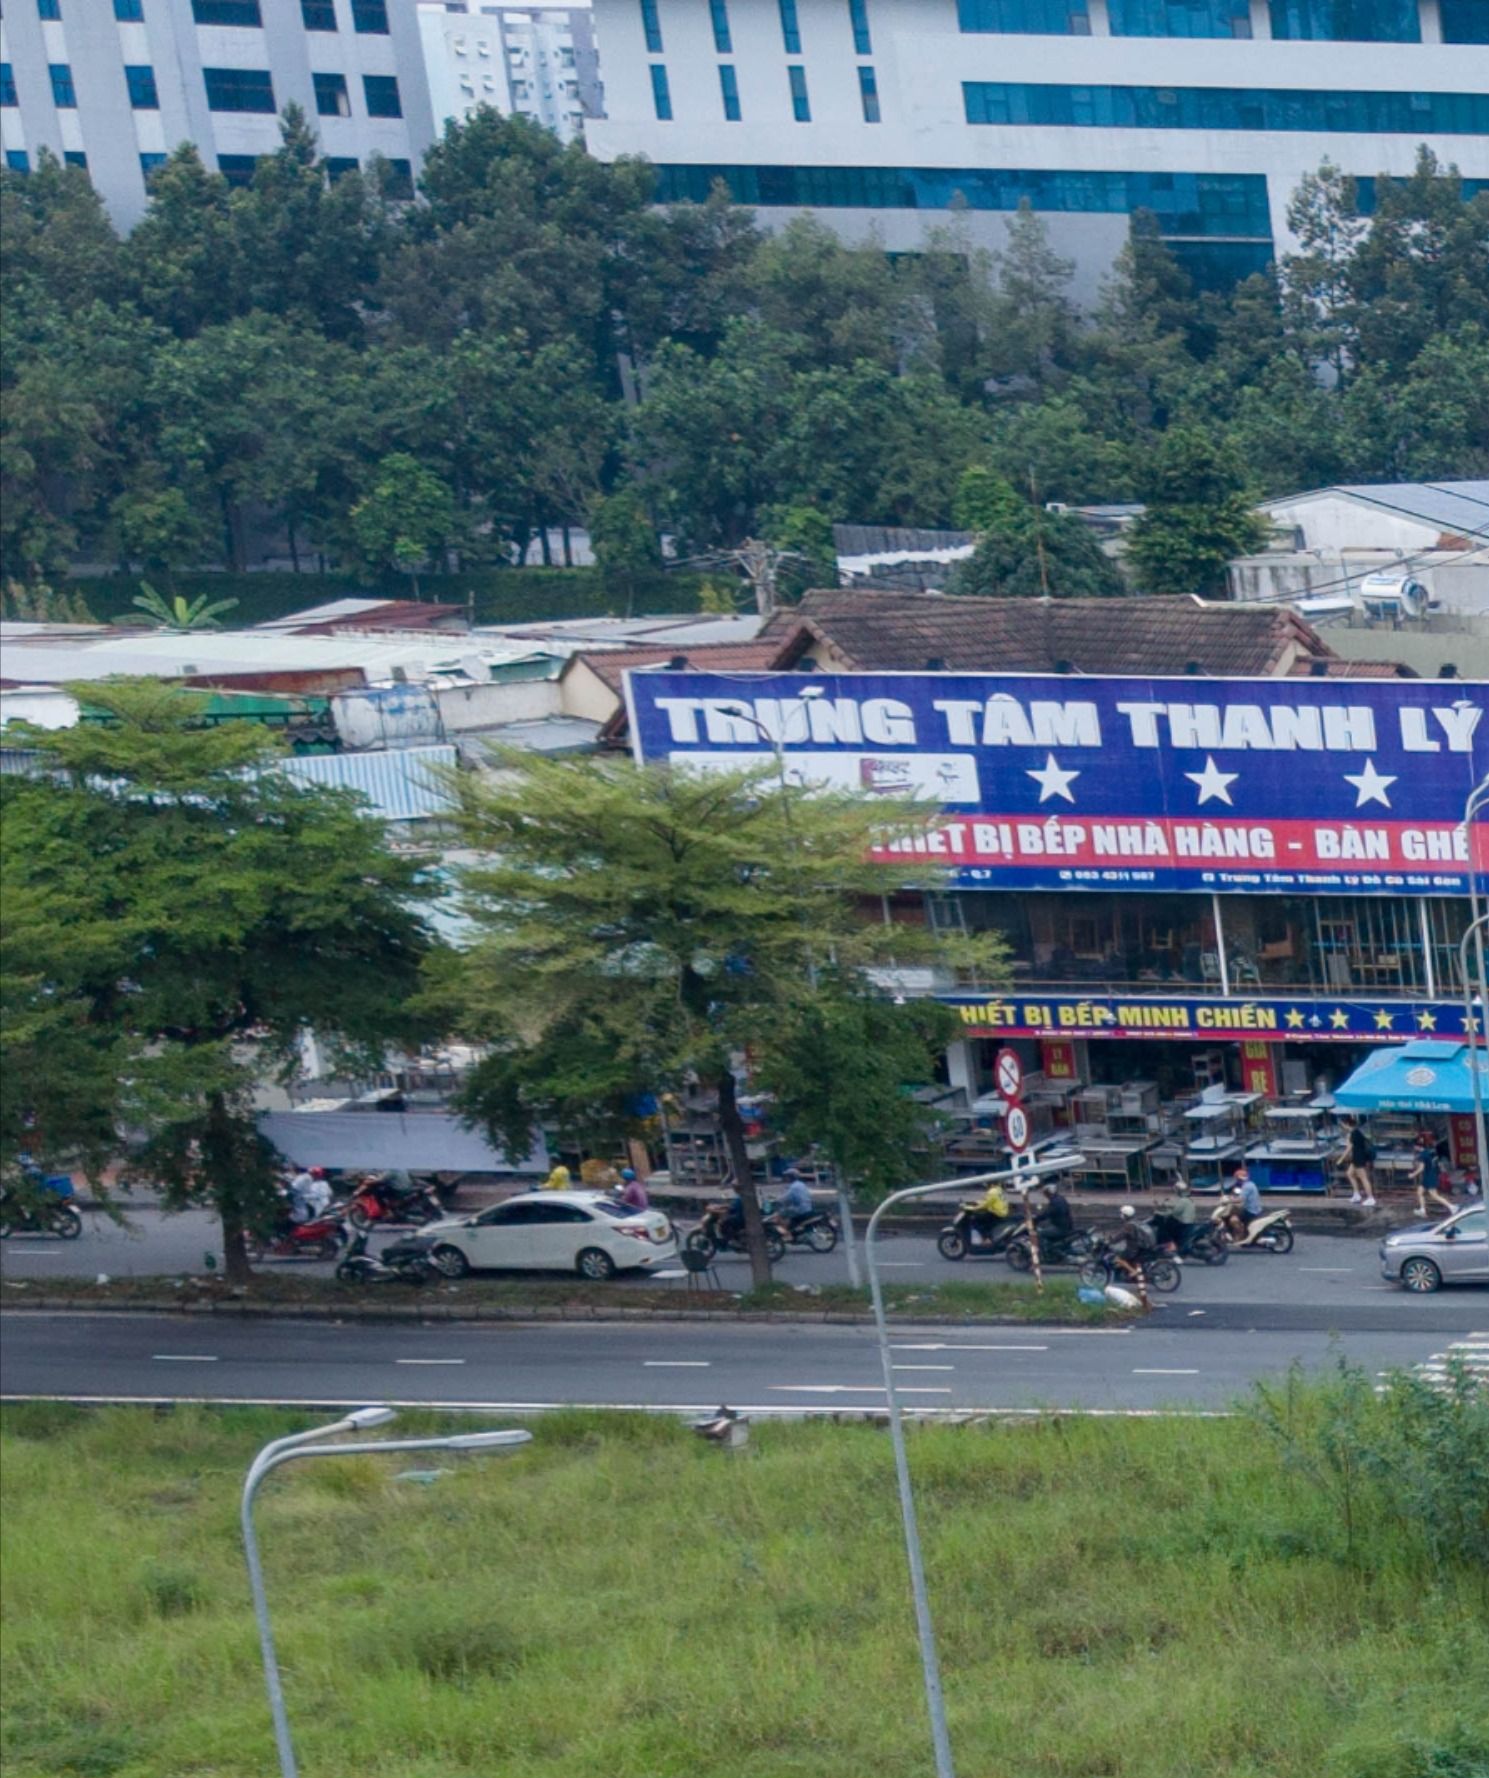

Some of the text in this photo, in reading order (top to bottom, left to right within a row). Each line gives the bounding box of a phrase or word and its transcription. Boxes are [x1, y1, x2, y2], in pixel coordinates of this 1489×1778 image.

[653, 697, 917, 745] TRUNG
[933, 692, 1102, 747] TÂM
[1116, 702, 1377, 752] THANH
[1399, 699, 1484, 754] LÝ
[973, 822, 1014, 860] BỊ
[1016, 813, 1087, 855] BẾP
[1092, 821, 1170, 856] NHÀ
[1173, 824, 1276, 858] HÀNG
[1314, 824, 1391, 860] BÀN
[960, 1000, 1277, 1029] HIẾT BỊ BẾP MINH CHIẾN
